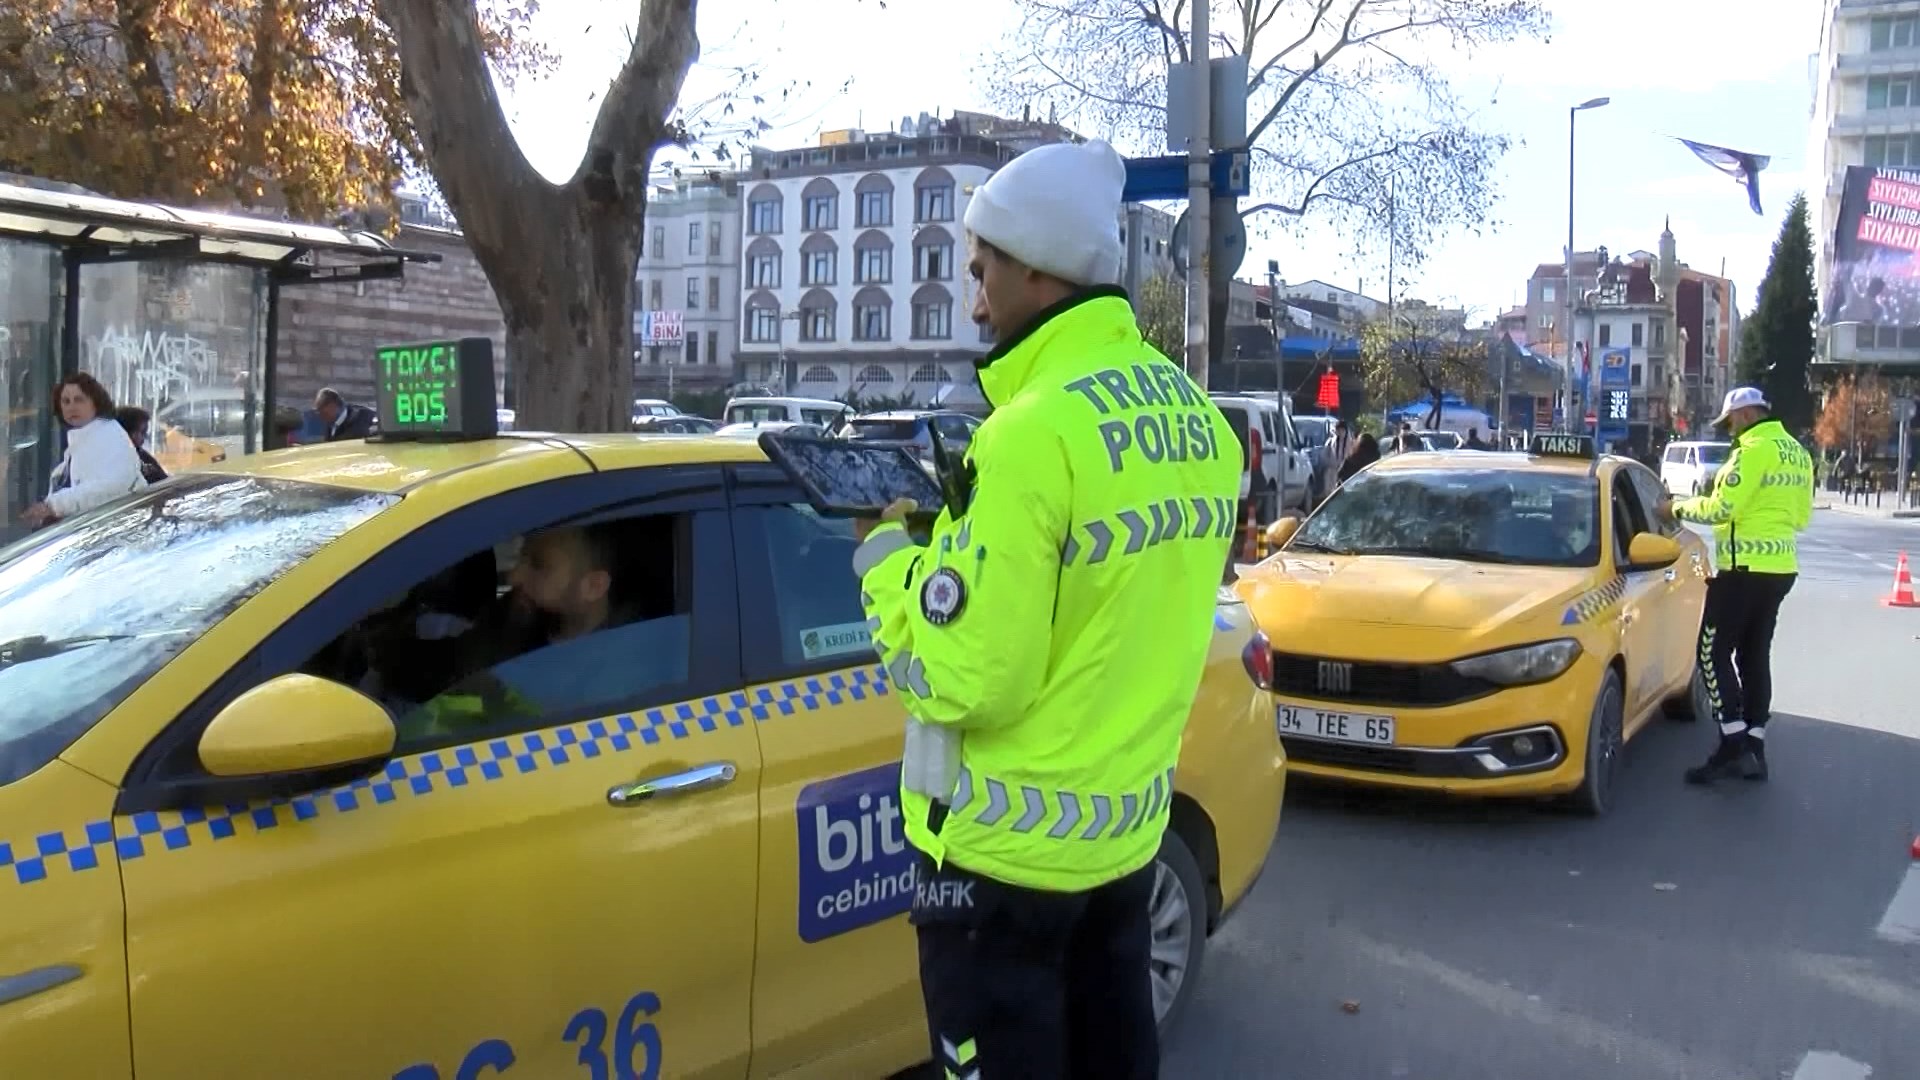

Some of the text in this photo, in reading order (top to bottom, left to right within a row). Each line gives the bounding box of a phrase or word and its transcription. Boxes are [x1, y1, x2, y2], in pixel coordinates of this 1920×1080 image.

[1064, 363, 1206, 414] TRAFİK
[1098, 413, 1219, 473] POLİSİ
[1318, 661, 1353, 692] FIAT
[1282, 708, 1390, 740] 34 TEE 65
[815, 792, 905, 873] bit
[817, 862, 916, 919] cebind
[562, 991, 662, 1080] 36
